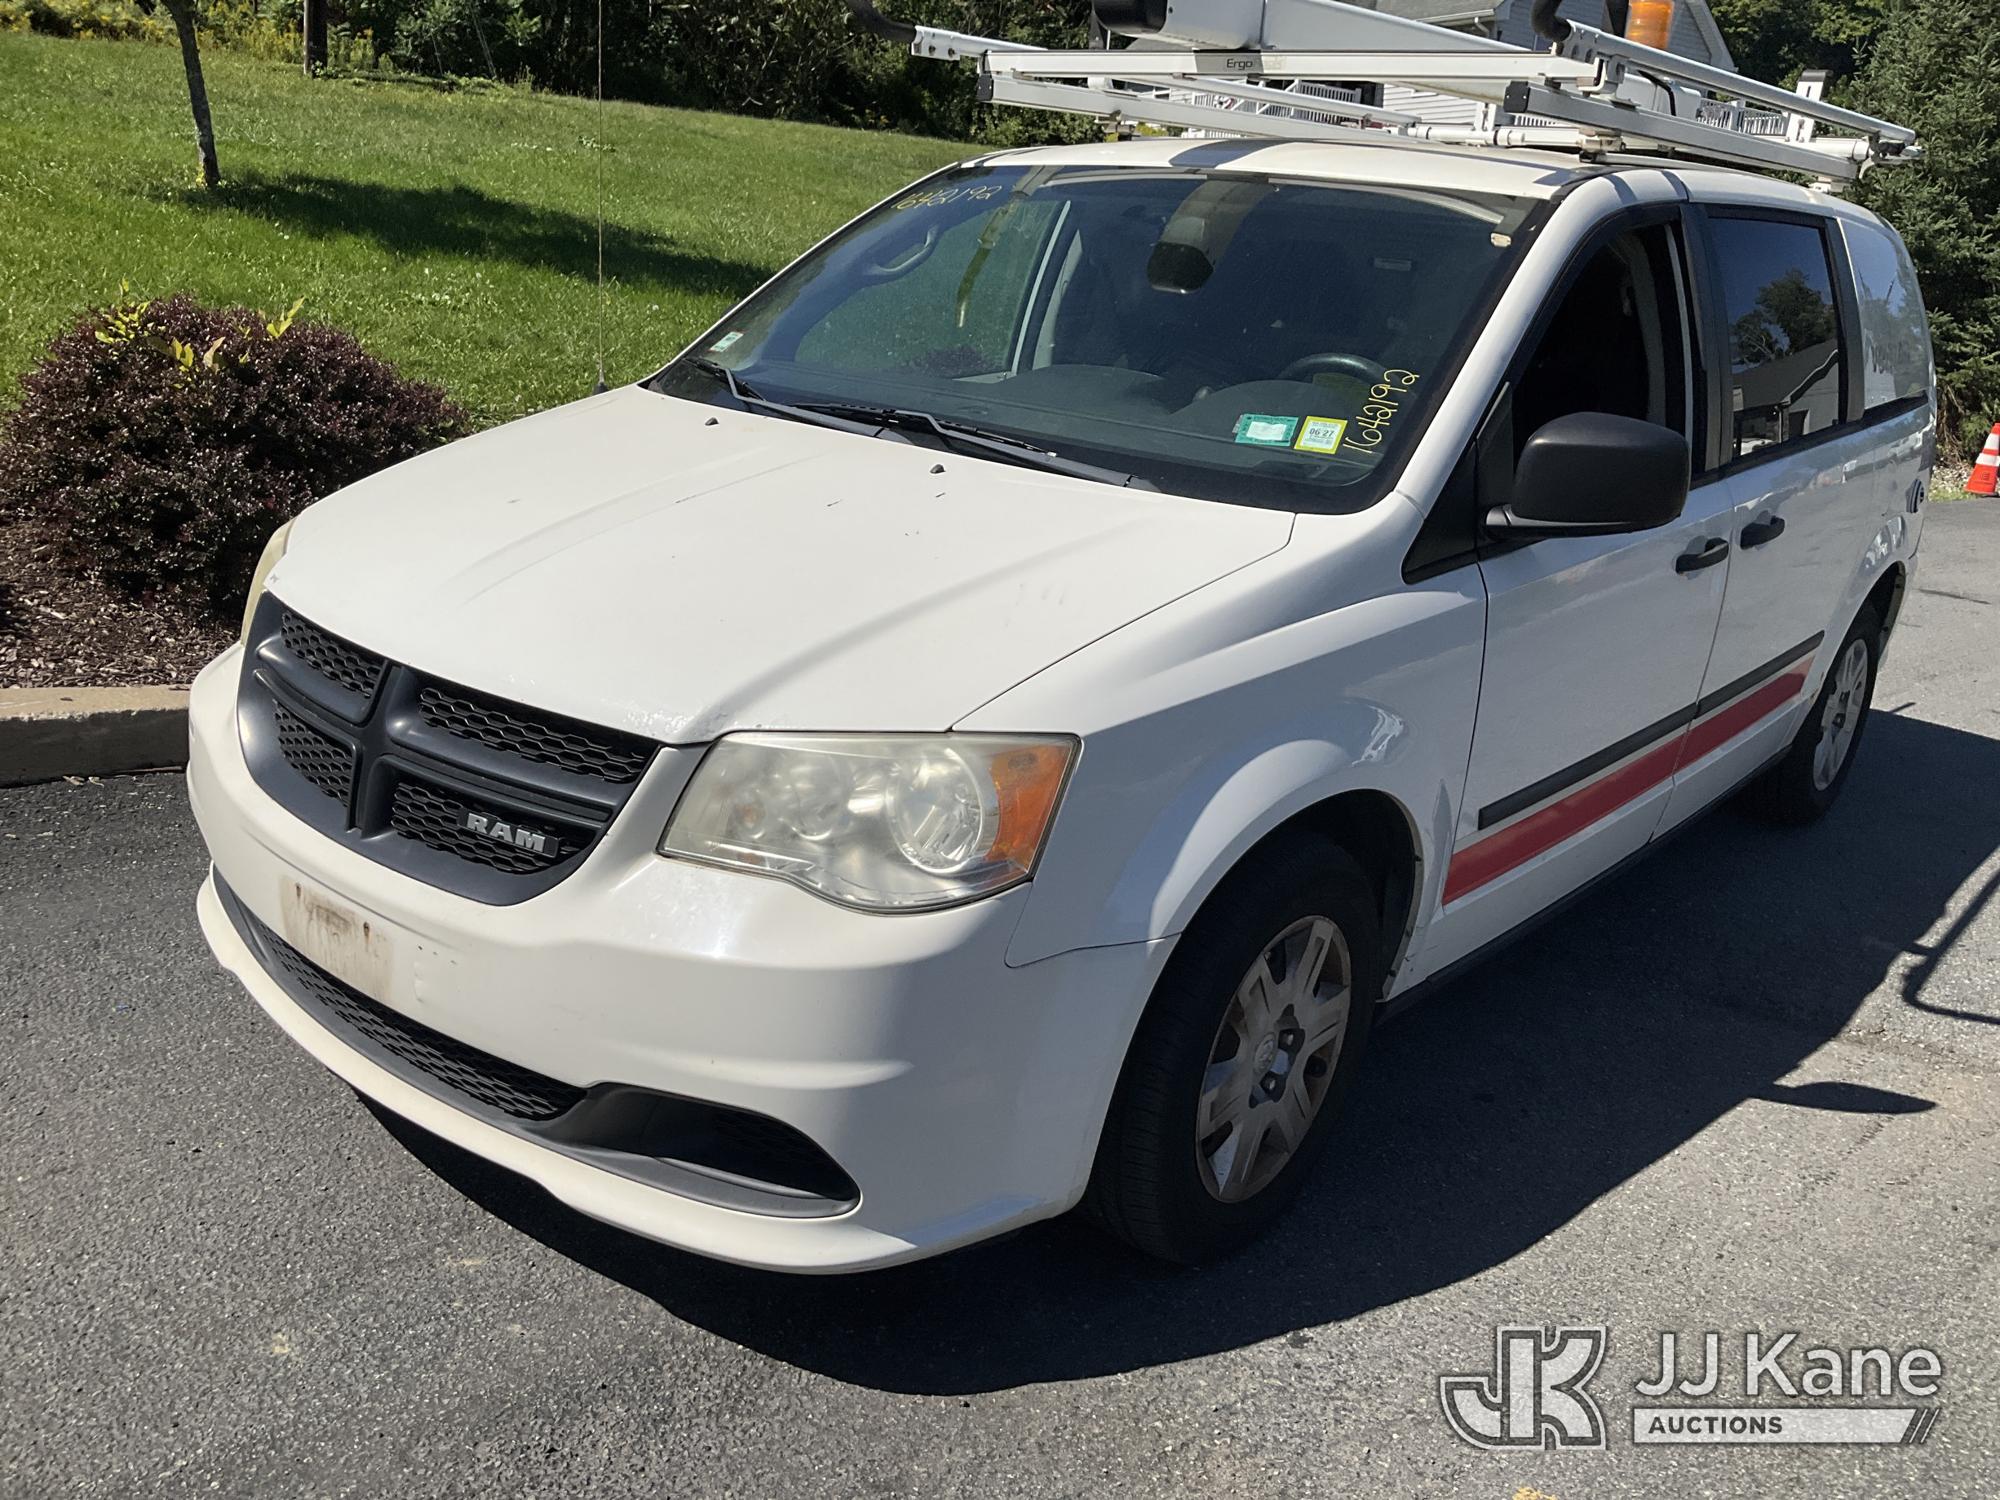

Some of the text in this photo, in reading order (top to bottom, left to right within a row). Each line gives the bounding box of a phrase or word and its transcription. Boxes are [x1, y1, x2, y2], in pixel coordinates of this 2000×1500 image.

[1226, 58, 1254, 71] Ergo
[1342, 369, 1420, 453] 1642192
[1310, 428, 1335, 438] 06 27
[466, 812, 546, 853] RAM
